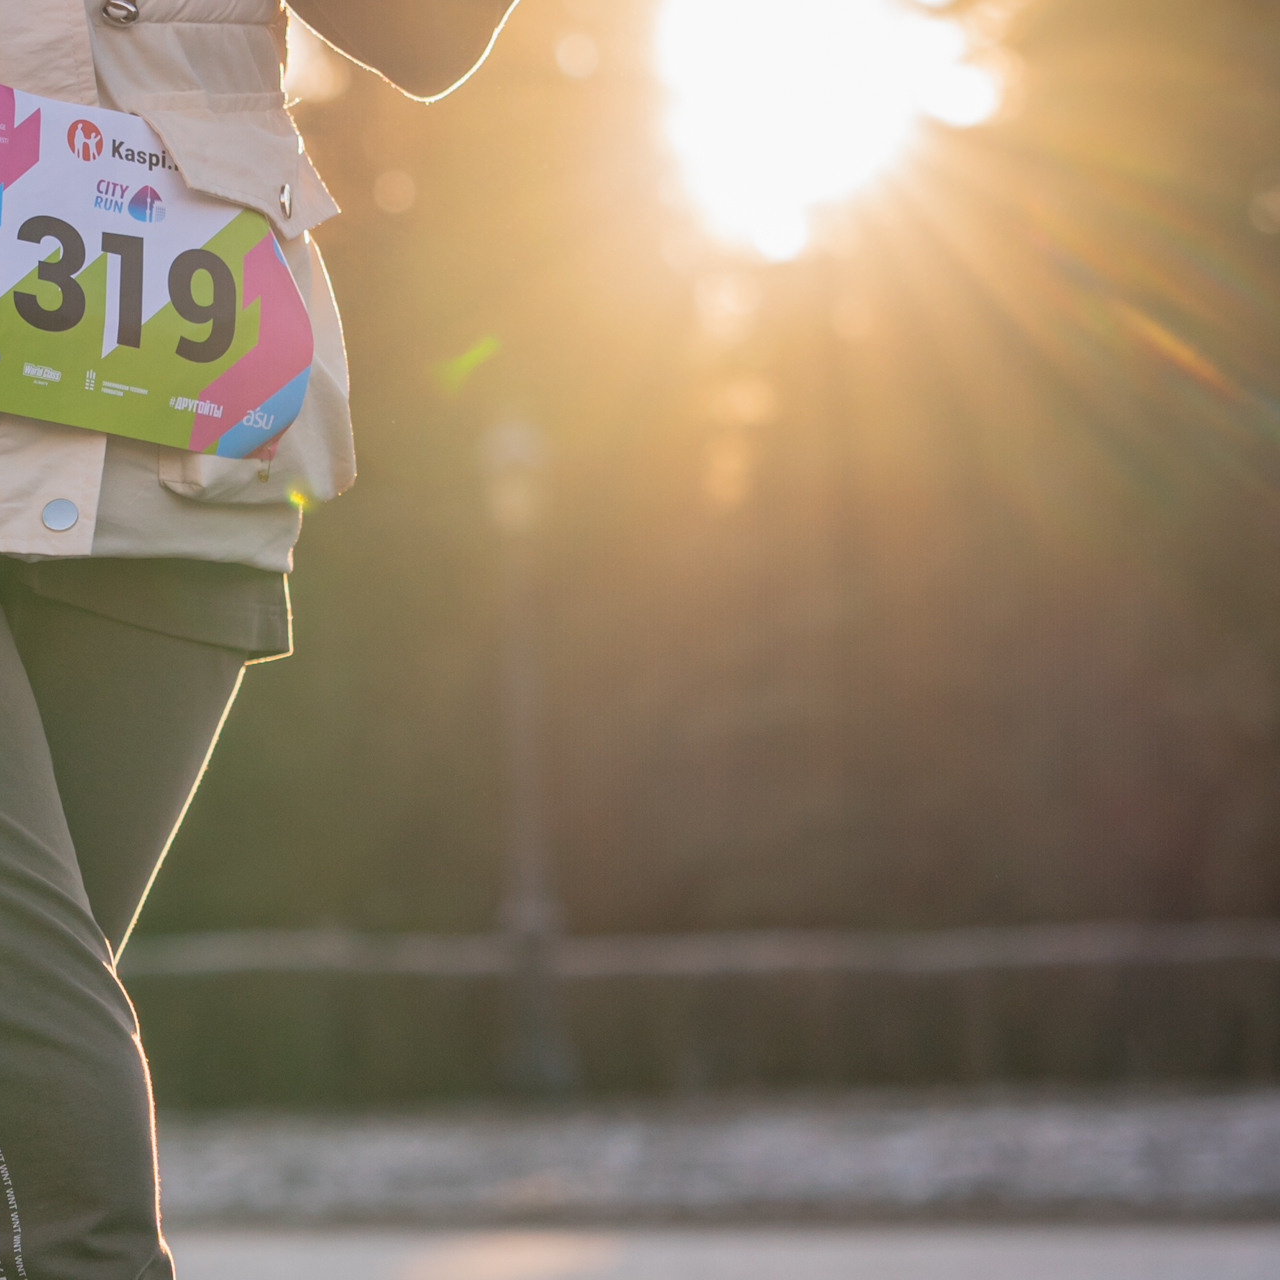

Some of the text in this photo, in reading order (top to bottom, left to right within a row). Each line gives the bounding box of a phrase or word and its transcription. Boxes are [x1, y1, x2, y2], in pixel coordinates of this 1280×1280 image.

[96, 179, 130, 199] CITY
[94, 196, 124, 214] RUN
[13, 215, 236, 363] 319
[24, 365, 60, 380] World Class
[0, 1164, 12, 1185] WNT
[6, 1188, 18, 1210] WNT
[10, 1212, 21, 1232] WNT
[13, 1233, 22, 1253] WNT
[14, 1255, 27, 1276] WNT
